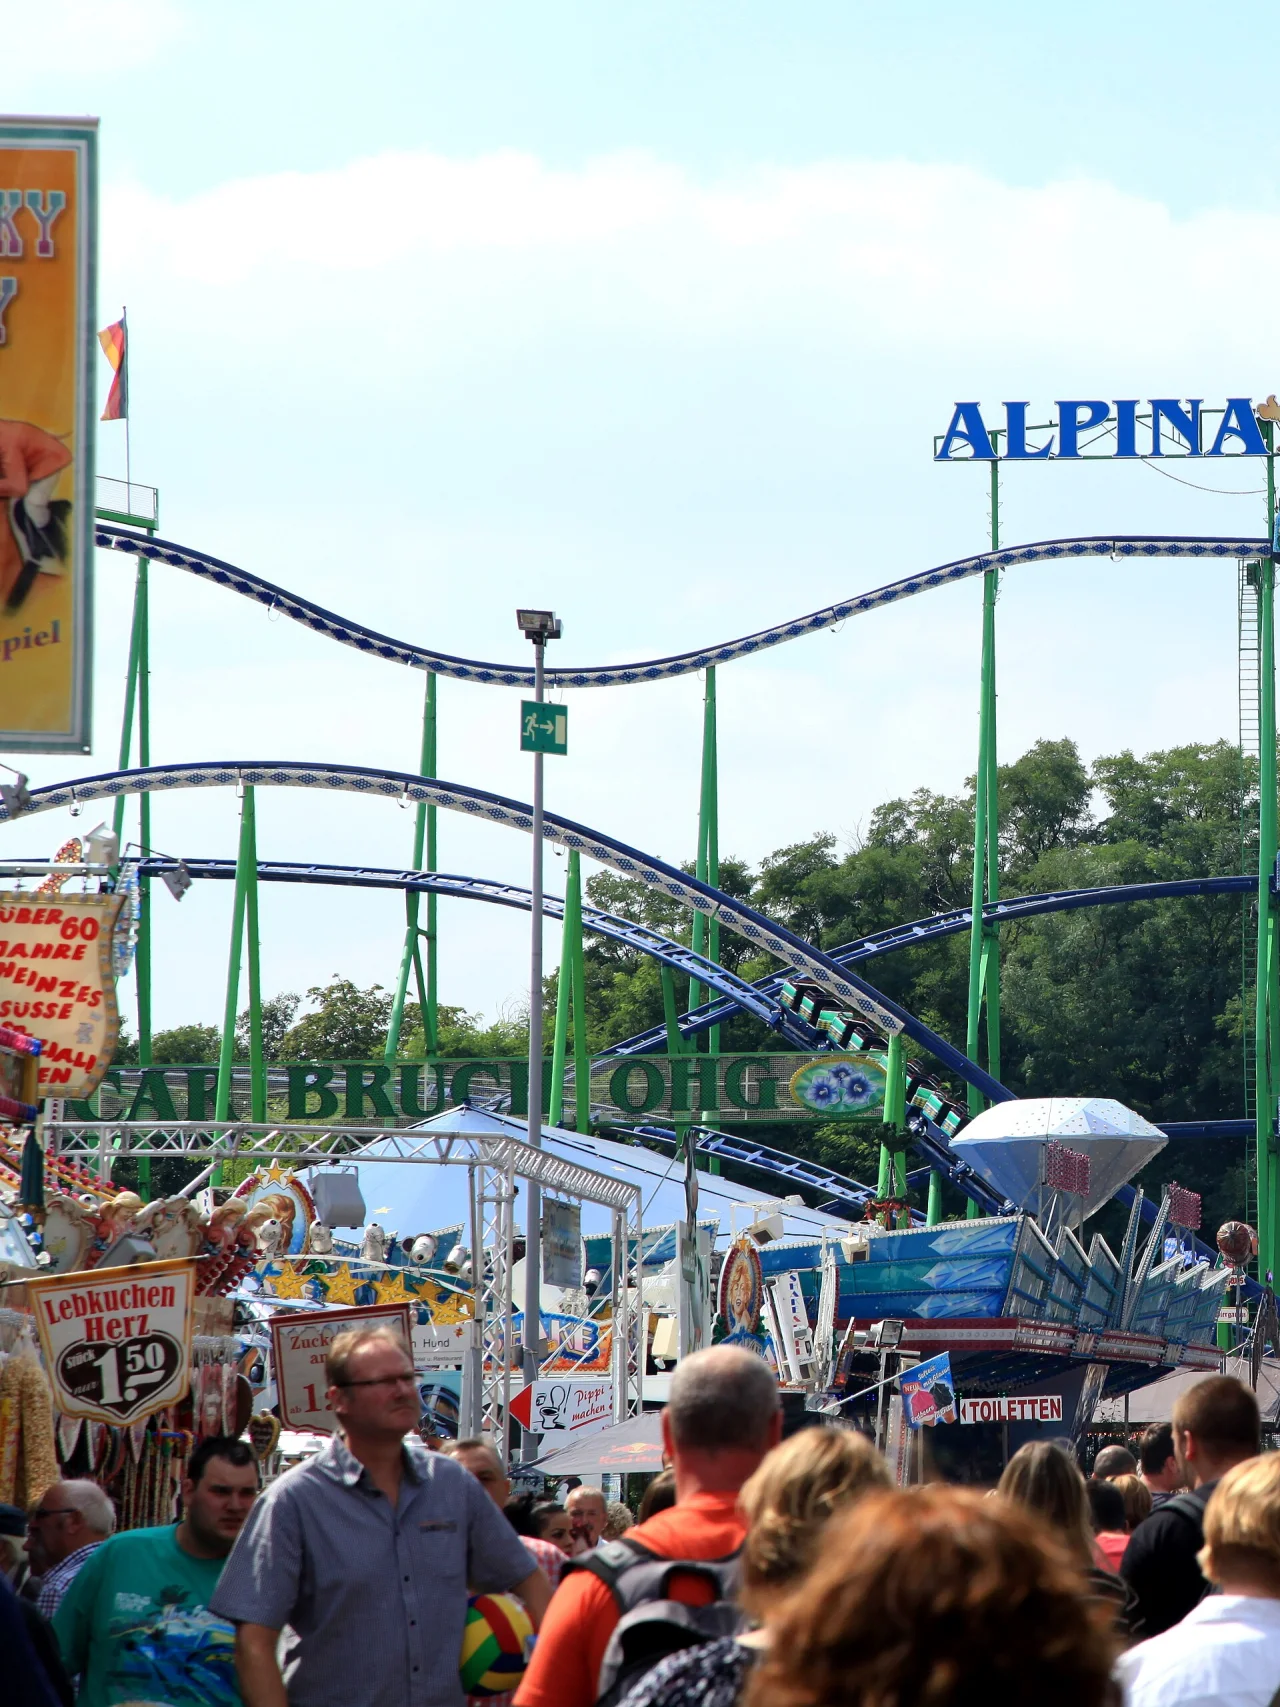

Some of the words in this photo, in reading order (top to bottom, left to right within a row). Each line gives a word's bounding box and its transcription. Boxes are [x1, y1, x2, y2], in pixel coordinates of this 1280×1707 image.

[933, 397, 1272, 460] ALPINA
[60, 916, 100, 941] 60
[609, 1056, 782, 1114] OHG
[44, 1283, 176, 1325] Lebkuchen
[84, 1314, 151, 1342] Herz
[422, 1338, 450, 1349] Hund
[66, 1349, 97, 1370] Stück
[574, 1385, 606, 1407] Pippi
[289, 1404, 302, 1415] ab
[571, 1402, 606, 1422] machen
[968, 1397, 1062, 1422] TOILETTEN
